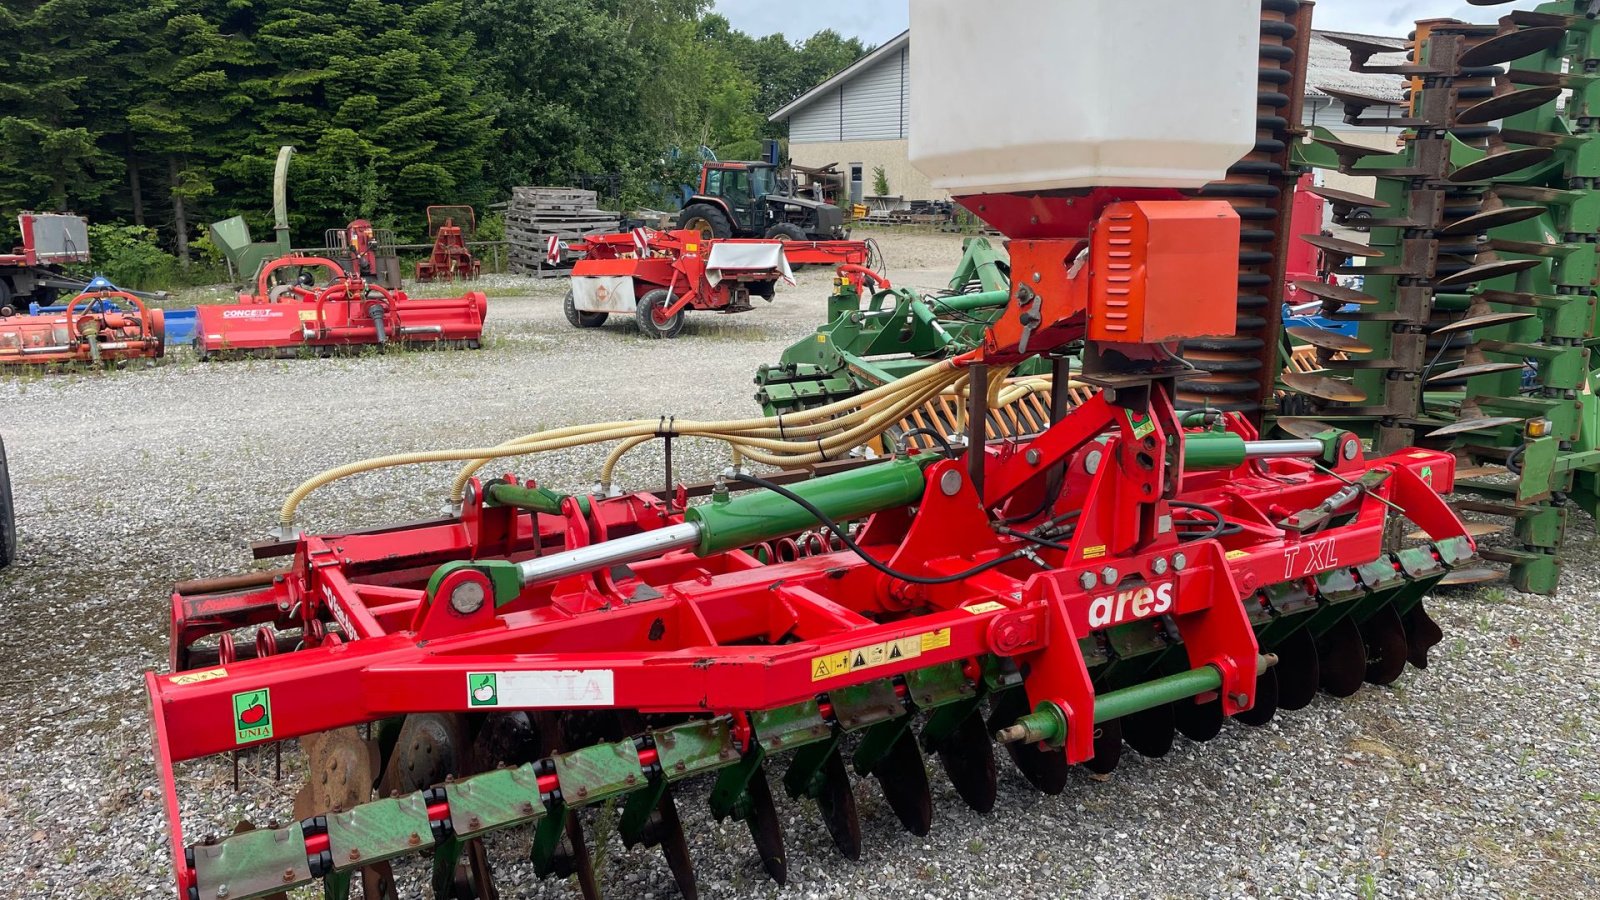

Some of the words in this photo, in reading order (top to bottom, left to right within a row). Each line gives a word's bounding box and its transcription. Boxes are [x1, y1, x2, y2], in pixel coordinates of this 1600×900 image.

[1284, 546, 1300, 579] T
[1303, 537, 1338, 574] XL
[1088, 582, 1173, 628] ares
[501, 674, 604, 701] IA
[238, 726, 270, 739] UNIA
